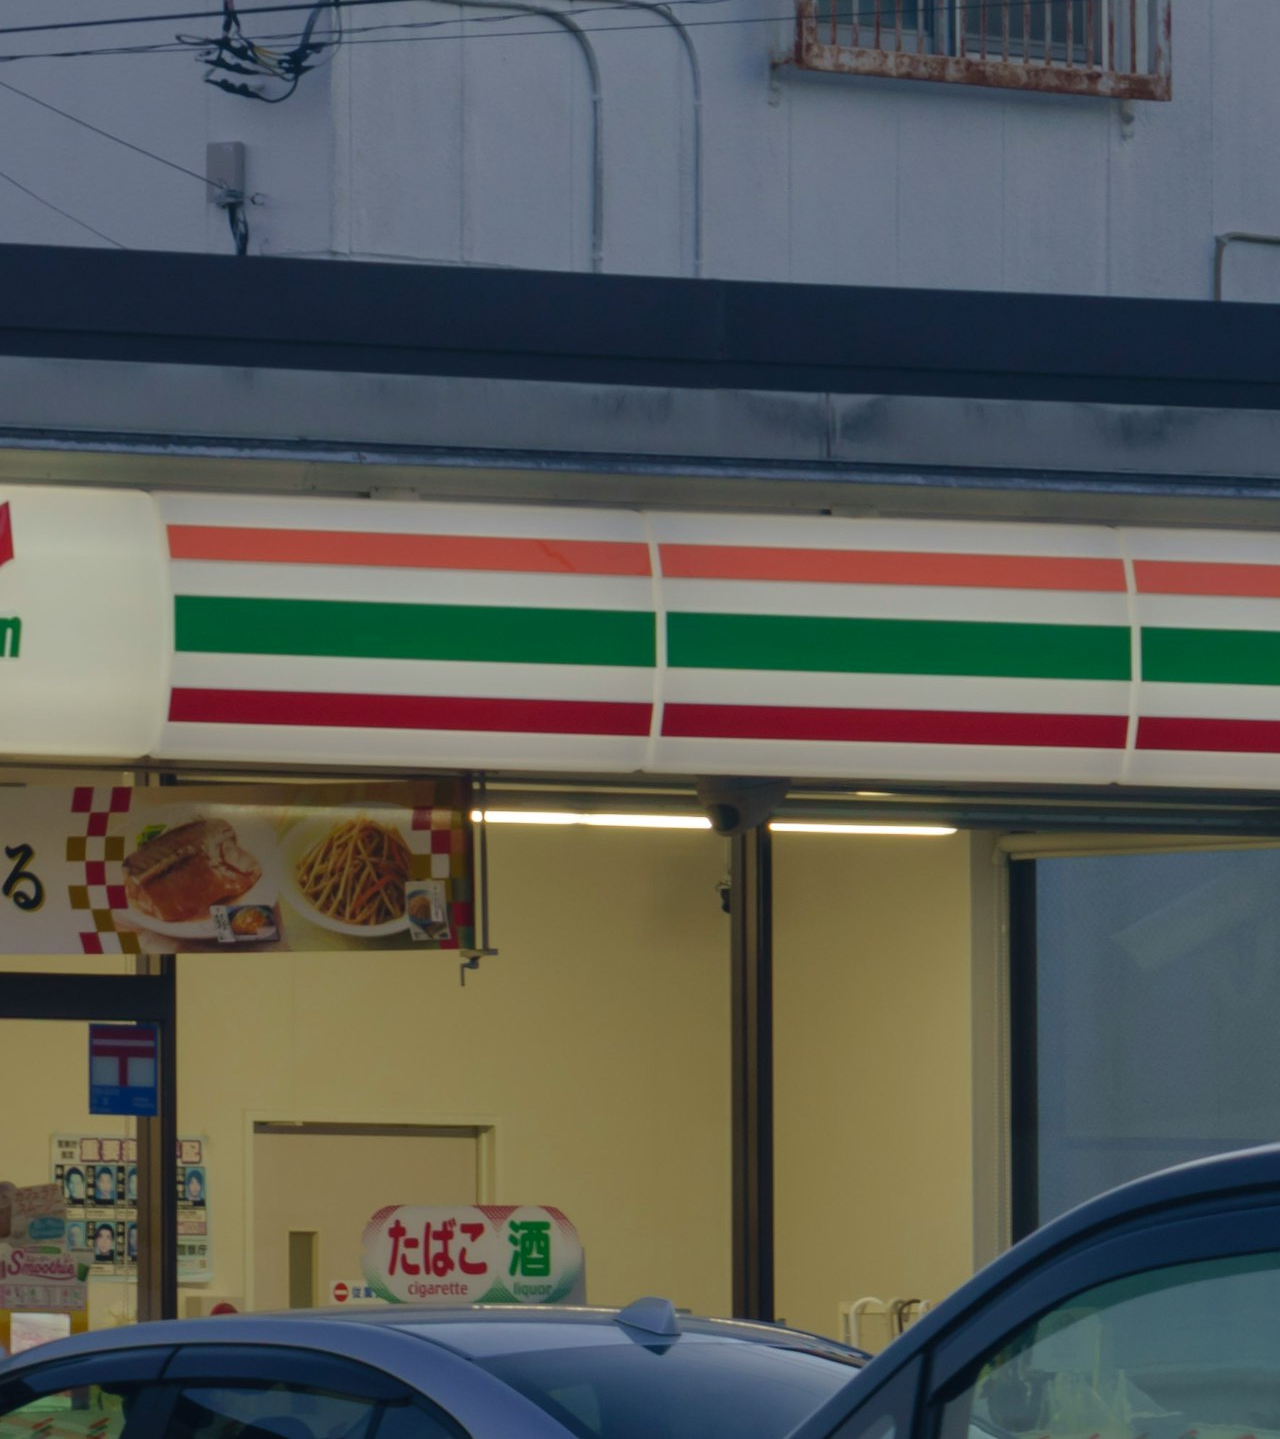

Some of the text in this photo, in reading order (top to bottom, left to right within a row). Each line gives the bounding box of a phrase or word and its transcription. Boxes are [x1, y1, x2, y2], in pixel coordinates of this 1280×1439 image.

[388, 1218, 551, 1277] たばこ 酒
[7, 1249, 75, 1276] Smoothie
[408, 1283, 553, 1296] cigarette liquor
